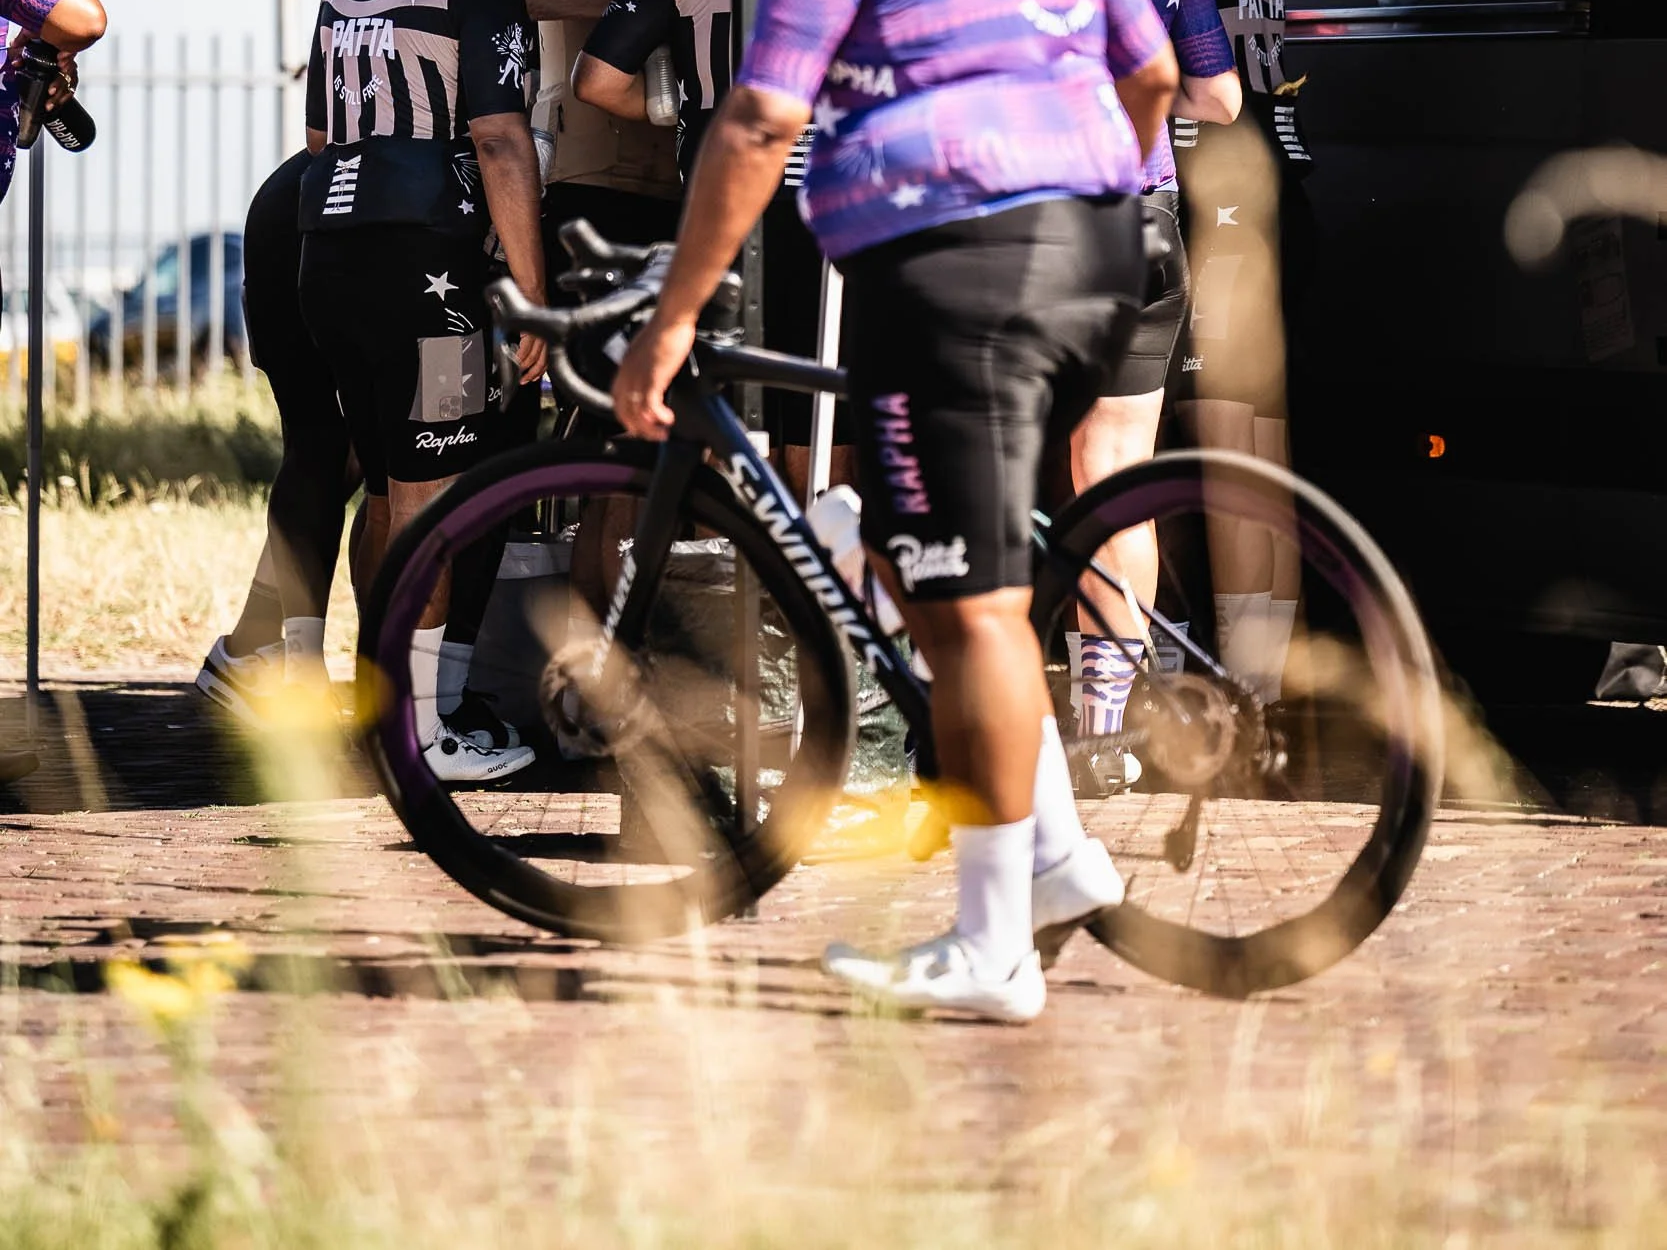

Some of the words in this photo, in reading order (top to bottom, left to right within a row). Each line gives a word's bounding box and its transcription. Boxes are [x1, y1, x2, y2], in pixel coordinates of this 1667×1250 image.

[331, 17, 396, 61] PATTA
[339, 86, 361, 105] STILL
[362, 74, 384, 103] FREE
[46, 118, 81, 149] RAPHA
